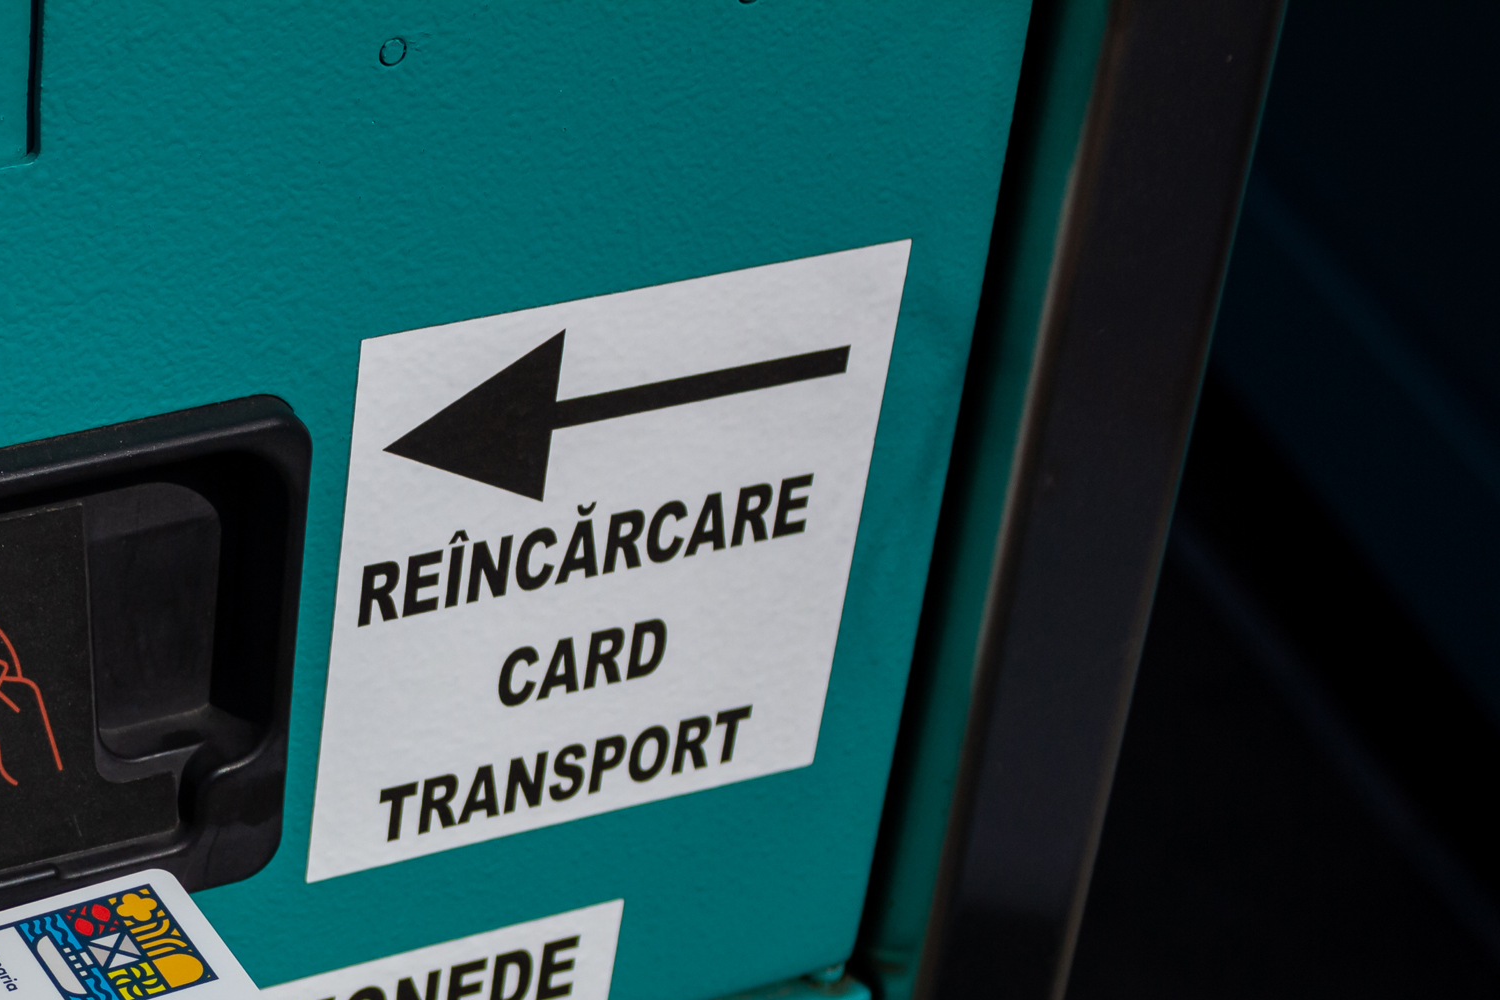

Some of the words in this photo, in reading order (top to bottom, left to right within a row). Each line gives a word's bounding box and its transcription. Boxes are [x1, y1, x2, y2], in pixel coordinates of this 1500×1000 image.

[356, 472, 815, 628] REÎNCĂRCARE
[497, 617, 668, 707] CARD
[379, 703, 753, 842] TRANSPORT
